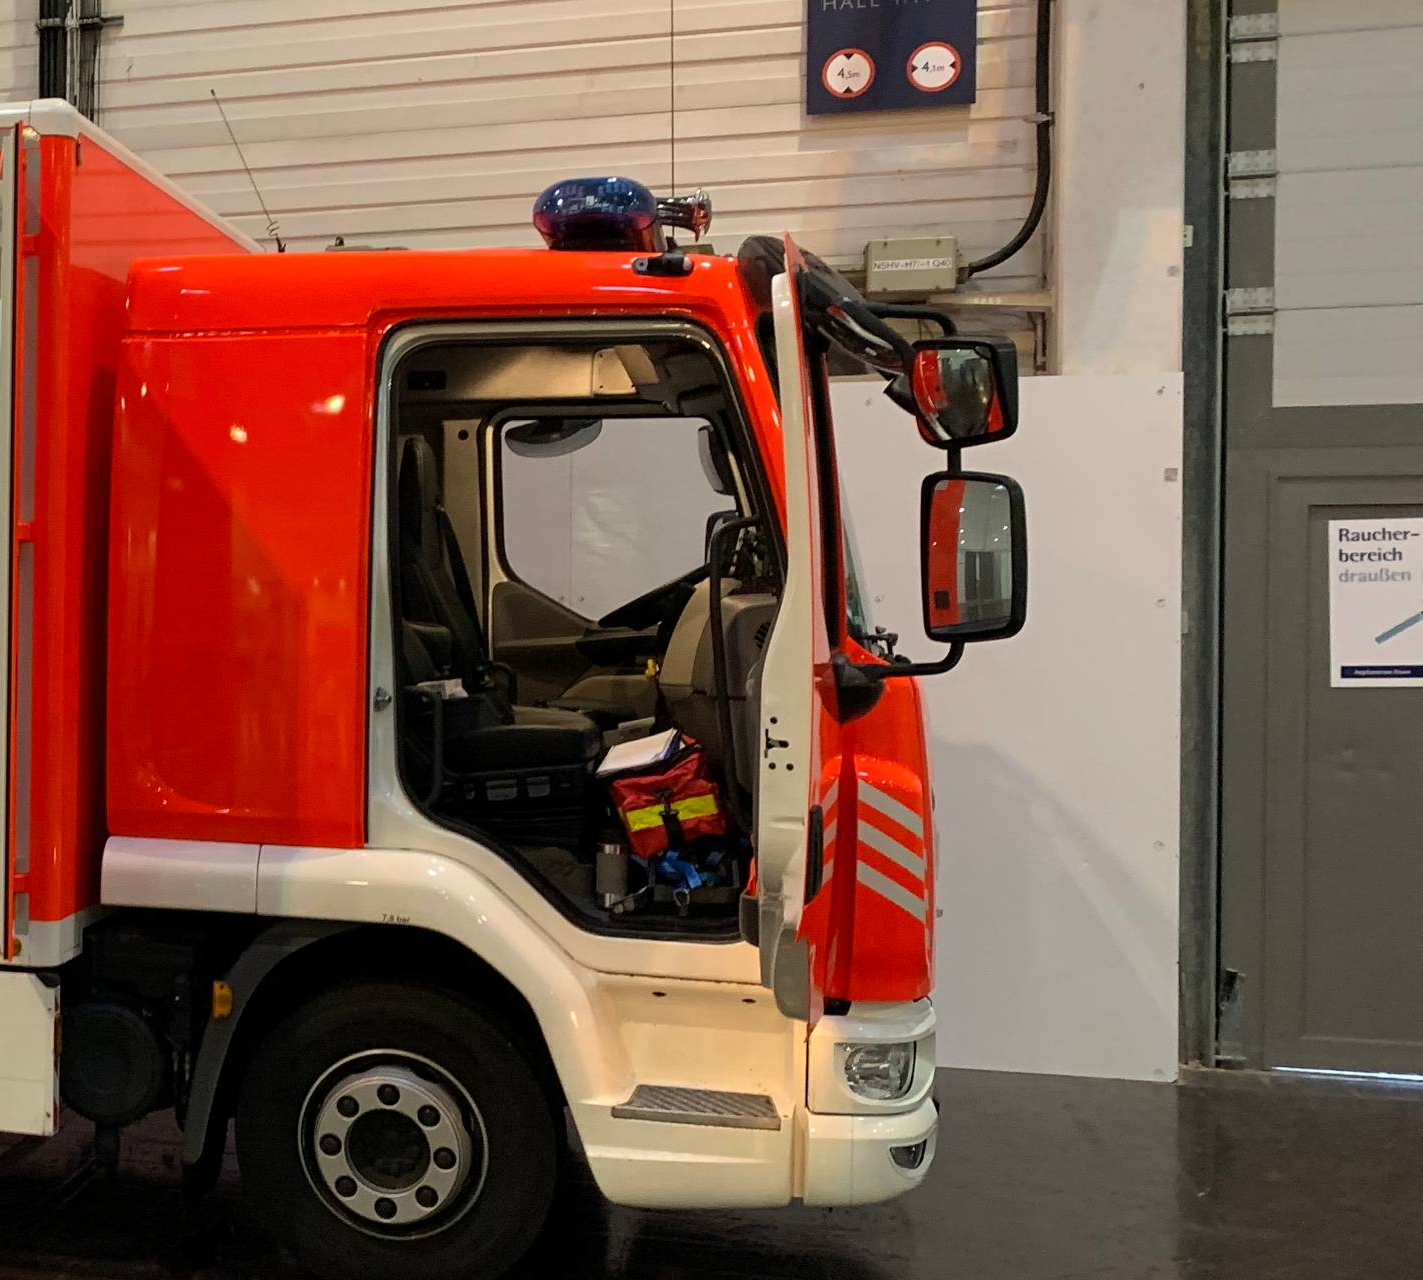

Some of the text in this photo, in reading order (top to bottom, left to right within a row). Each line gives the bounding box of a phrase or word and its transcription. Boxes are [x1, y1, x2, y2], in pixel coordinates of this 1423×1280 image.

[1338, 527, 1420, 542] Raucher-
[1339, 547, 1403, 563] bereich
[1339, 568, 1412, 583] draußen
